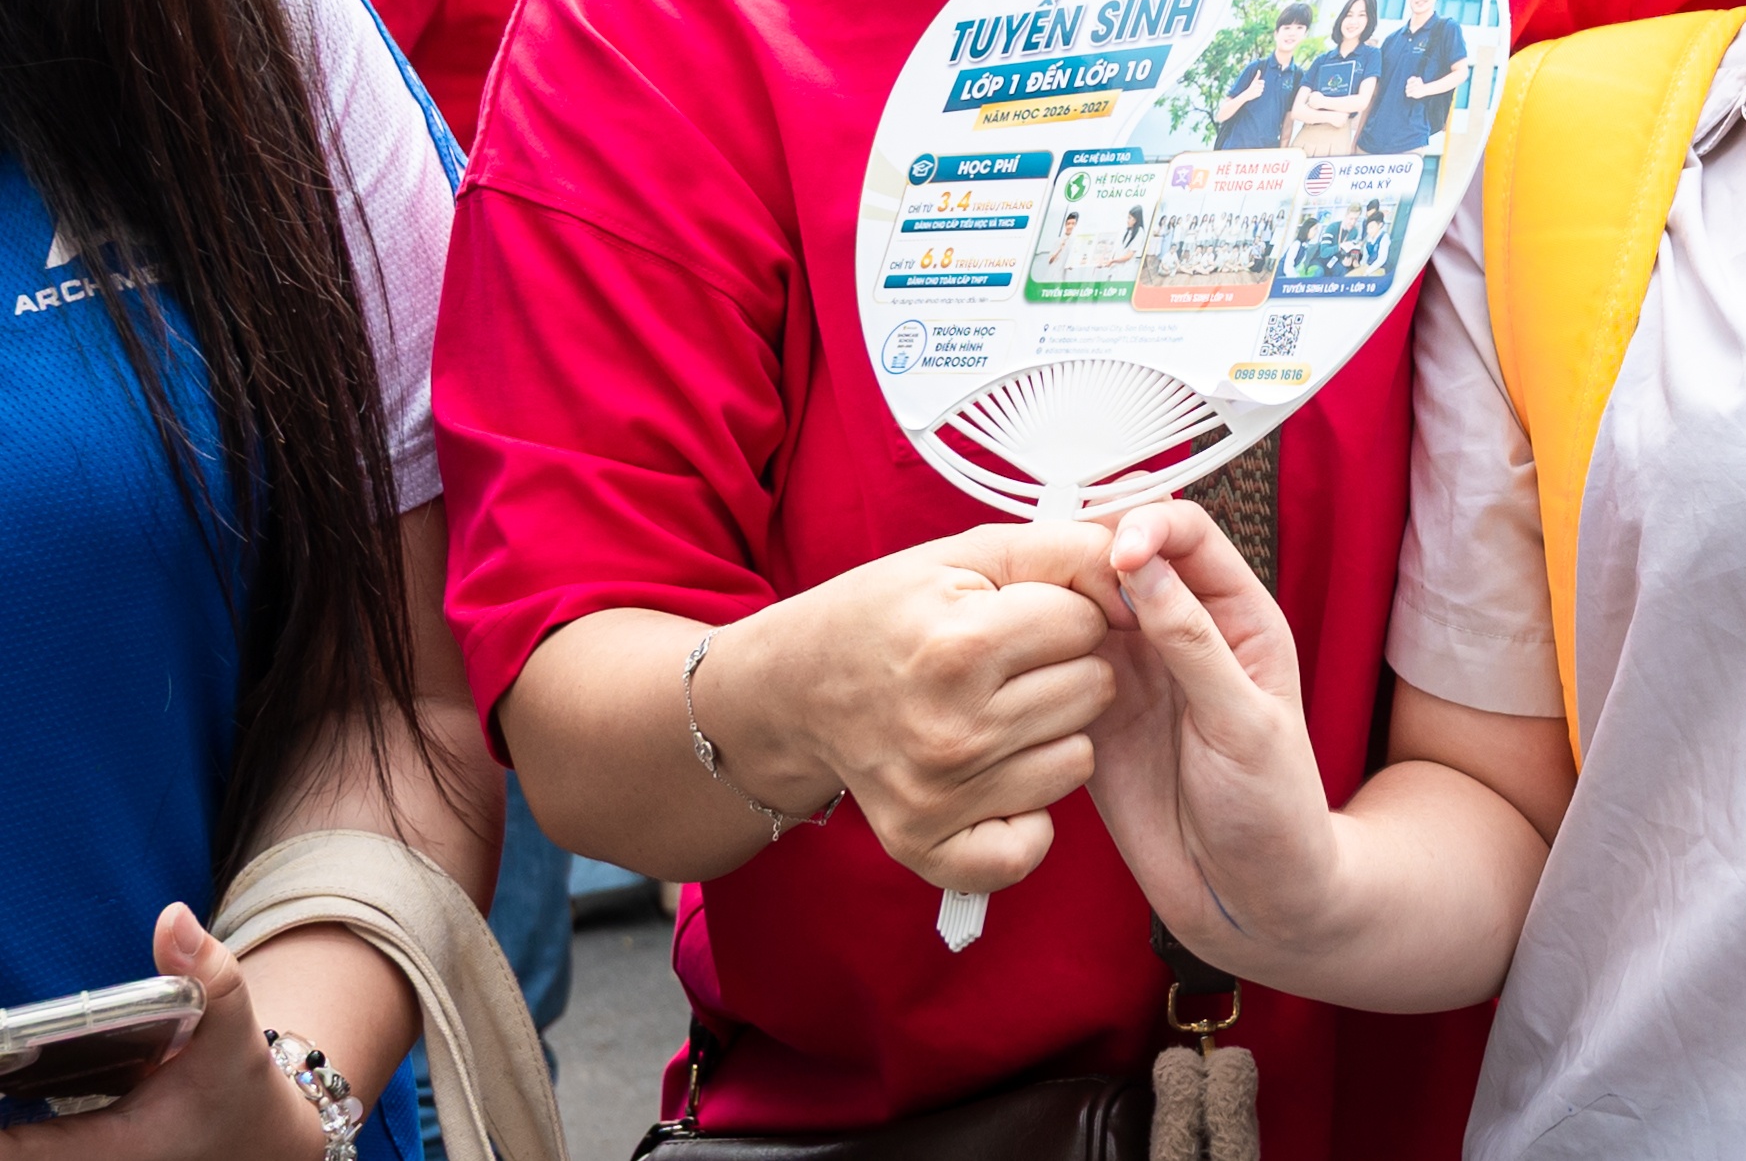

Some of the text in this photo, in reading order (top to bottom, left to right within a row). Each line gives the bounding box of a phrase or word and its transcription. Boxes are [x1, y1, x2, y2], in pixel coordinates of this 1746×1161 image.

[960, 58, 1152, 101] LỚP 1 ĐẾN LỚP 10
[982, 109, 1010, 125] NĂM
[1012, 107, 1040, 124] HỌC
[1042, 105, 1071, 119] 2026
[1080, 100, 1110, 114] 2027
[957, 154, 1021, 179] HỌC PHÍ
[1216, 159, 1290, 177] HỆ TAM NGỮ
[1338, 162, 1414, 177] HỆ SONG NGỮ
[1095, 171, 1156, 186] HỆ TÍCH HỢP
[1213, 179, 1284, 192] TRUNG ANH
[1350, 178, 1392, 190] HOA KỲ
[1096, 184, 1147, 198] TOÀN CẦU
[937, 190, 973, 212] 3.4
[920, 246, 955, 269] 6.8
[1094, 288, 1098, 297] 1
[1118, 288, 1127, 297] 10
[1340, 283, 1345, 293] 1
[1366, 283, 1376, 293] 10
[1225, 293, 1234, 302] 10
[932, 324, 996, 339] TRƯỜNG HỌC
[935, 338, 983, 352] ĐIỂN HÌNH
[921, 356, 988, 368] MICROSOFT
[1234, 368, 1303, 381] 098 996 1616
